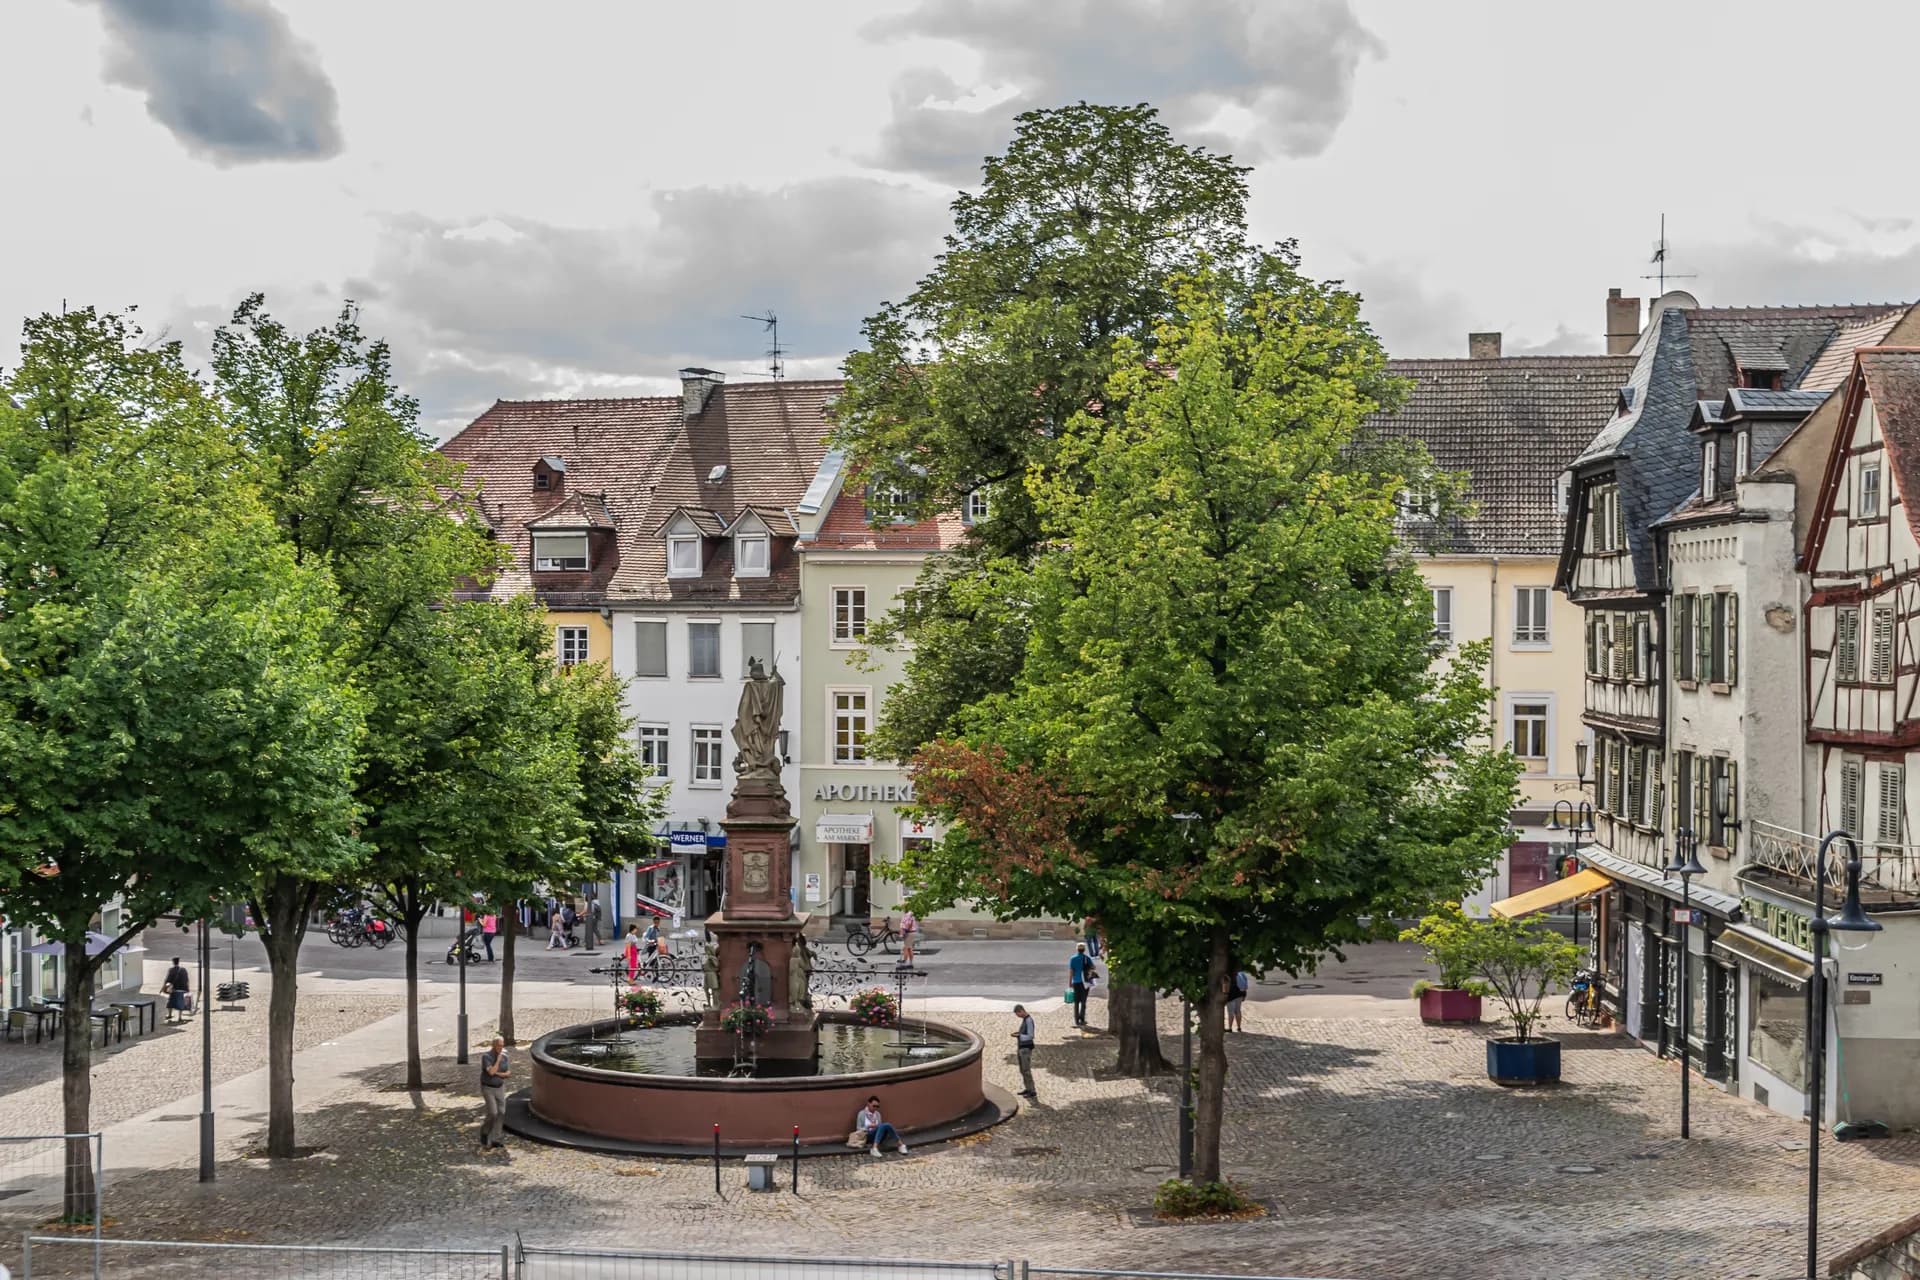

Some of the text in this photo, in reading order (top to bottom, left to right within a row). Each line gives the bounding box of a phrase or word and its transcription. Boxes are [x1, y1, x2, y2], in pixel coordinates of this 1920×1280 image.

[815, 783, 918, 801] APOTHEKE
[824, 826, 860, 834] APOTHEKE
[673, 834, 705, 843] WERNER
